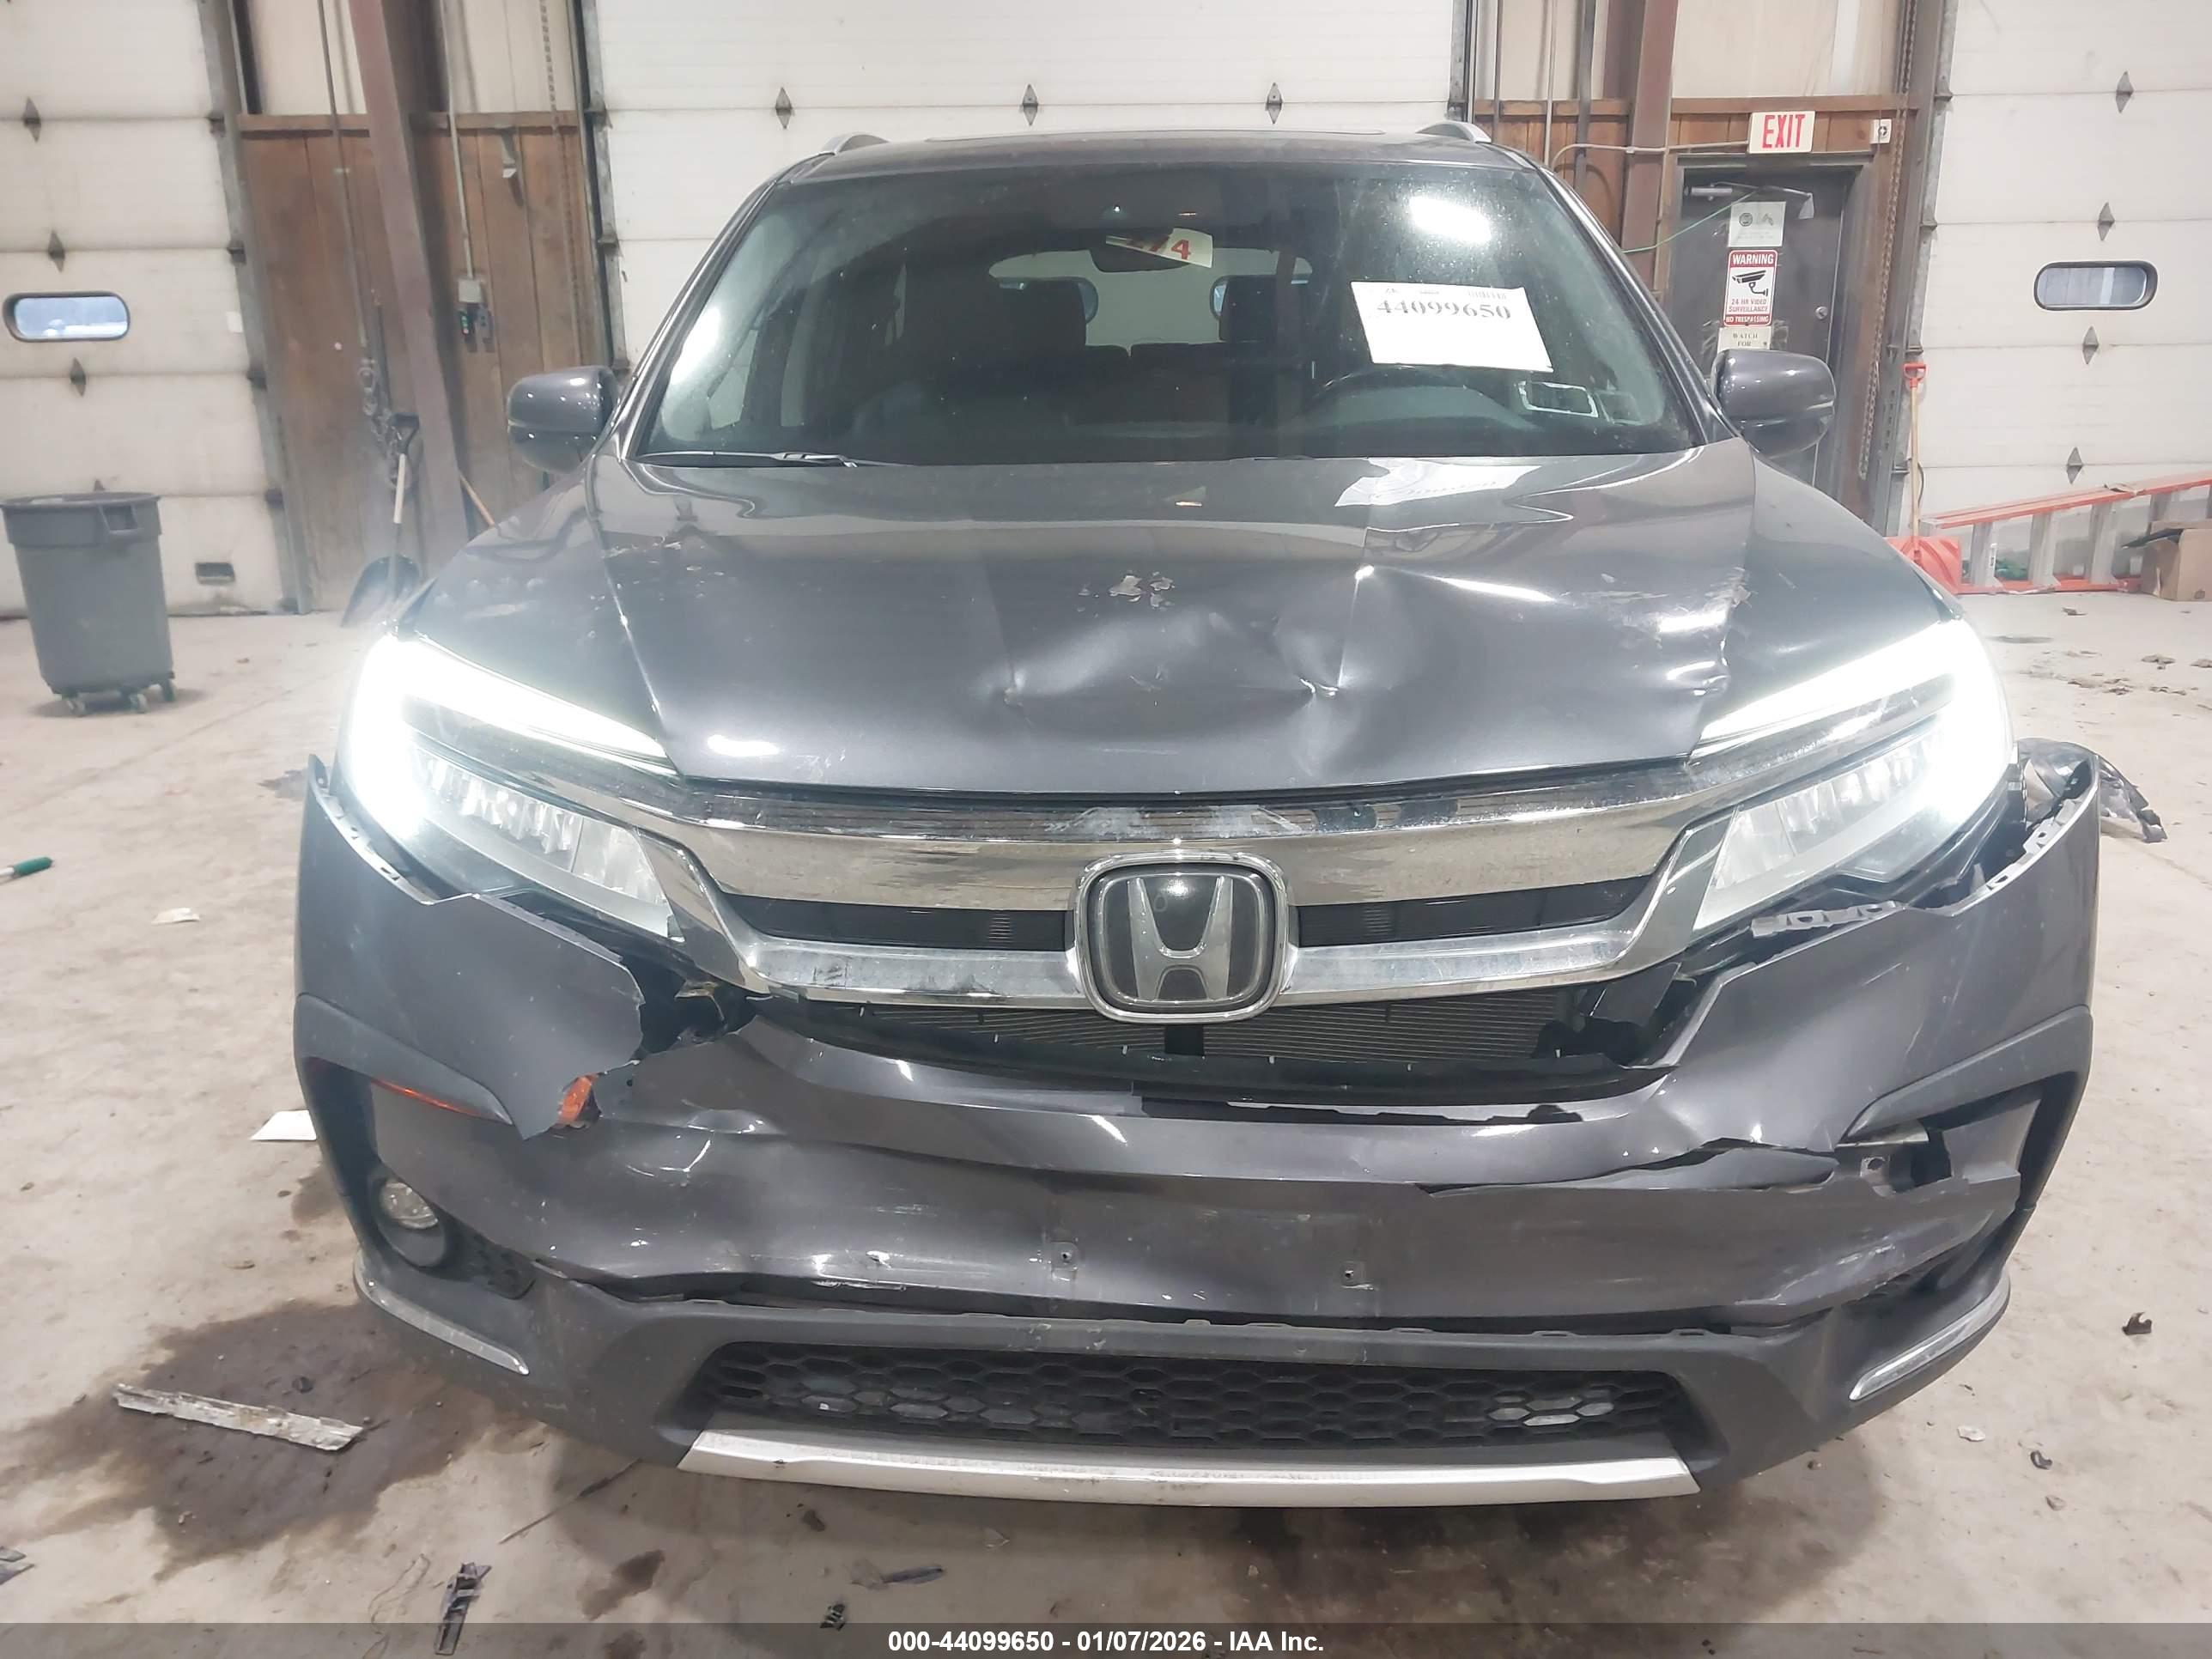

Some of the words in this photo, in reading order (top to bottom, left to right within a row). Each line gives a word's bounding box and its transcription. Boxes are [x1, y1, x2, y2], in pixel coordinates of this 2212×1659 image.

[1762, 113, 1806, 149] EXIT
[1732, 253, 1774, 264] WARNING
[1376, 300, 1512, 319] 44099650
